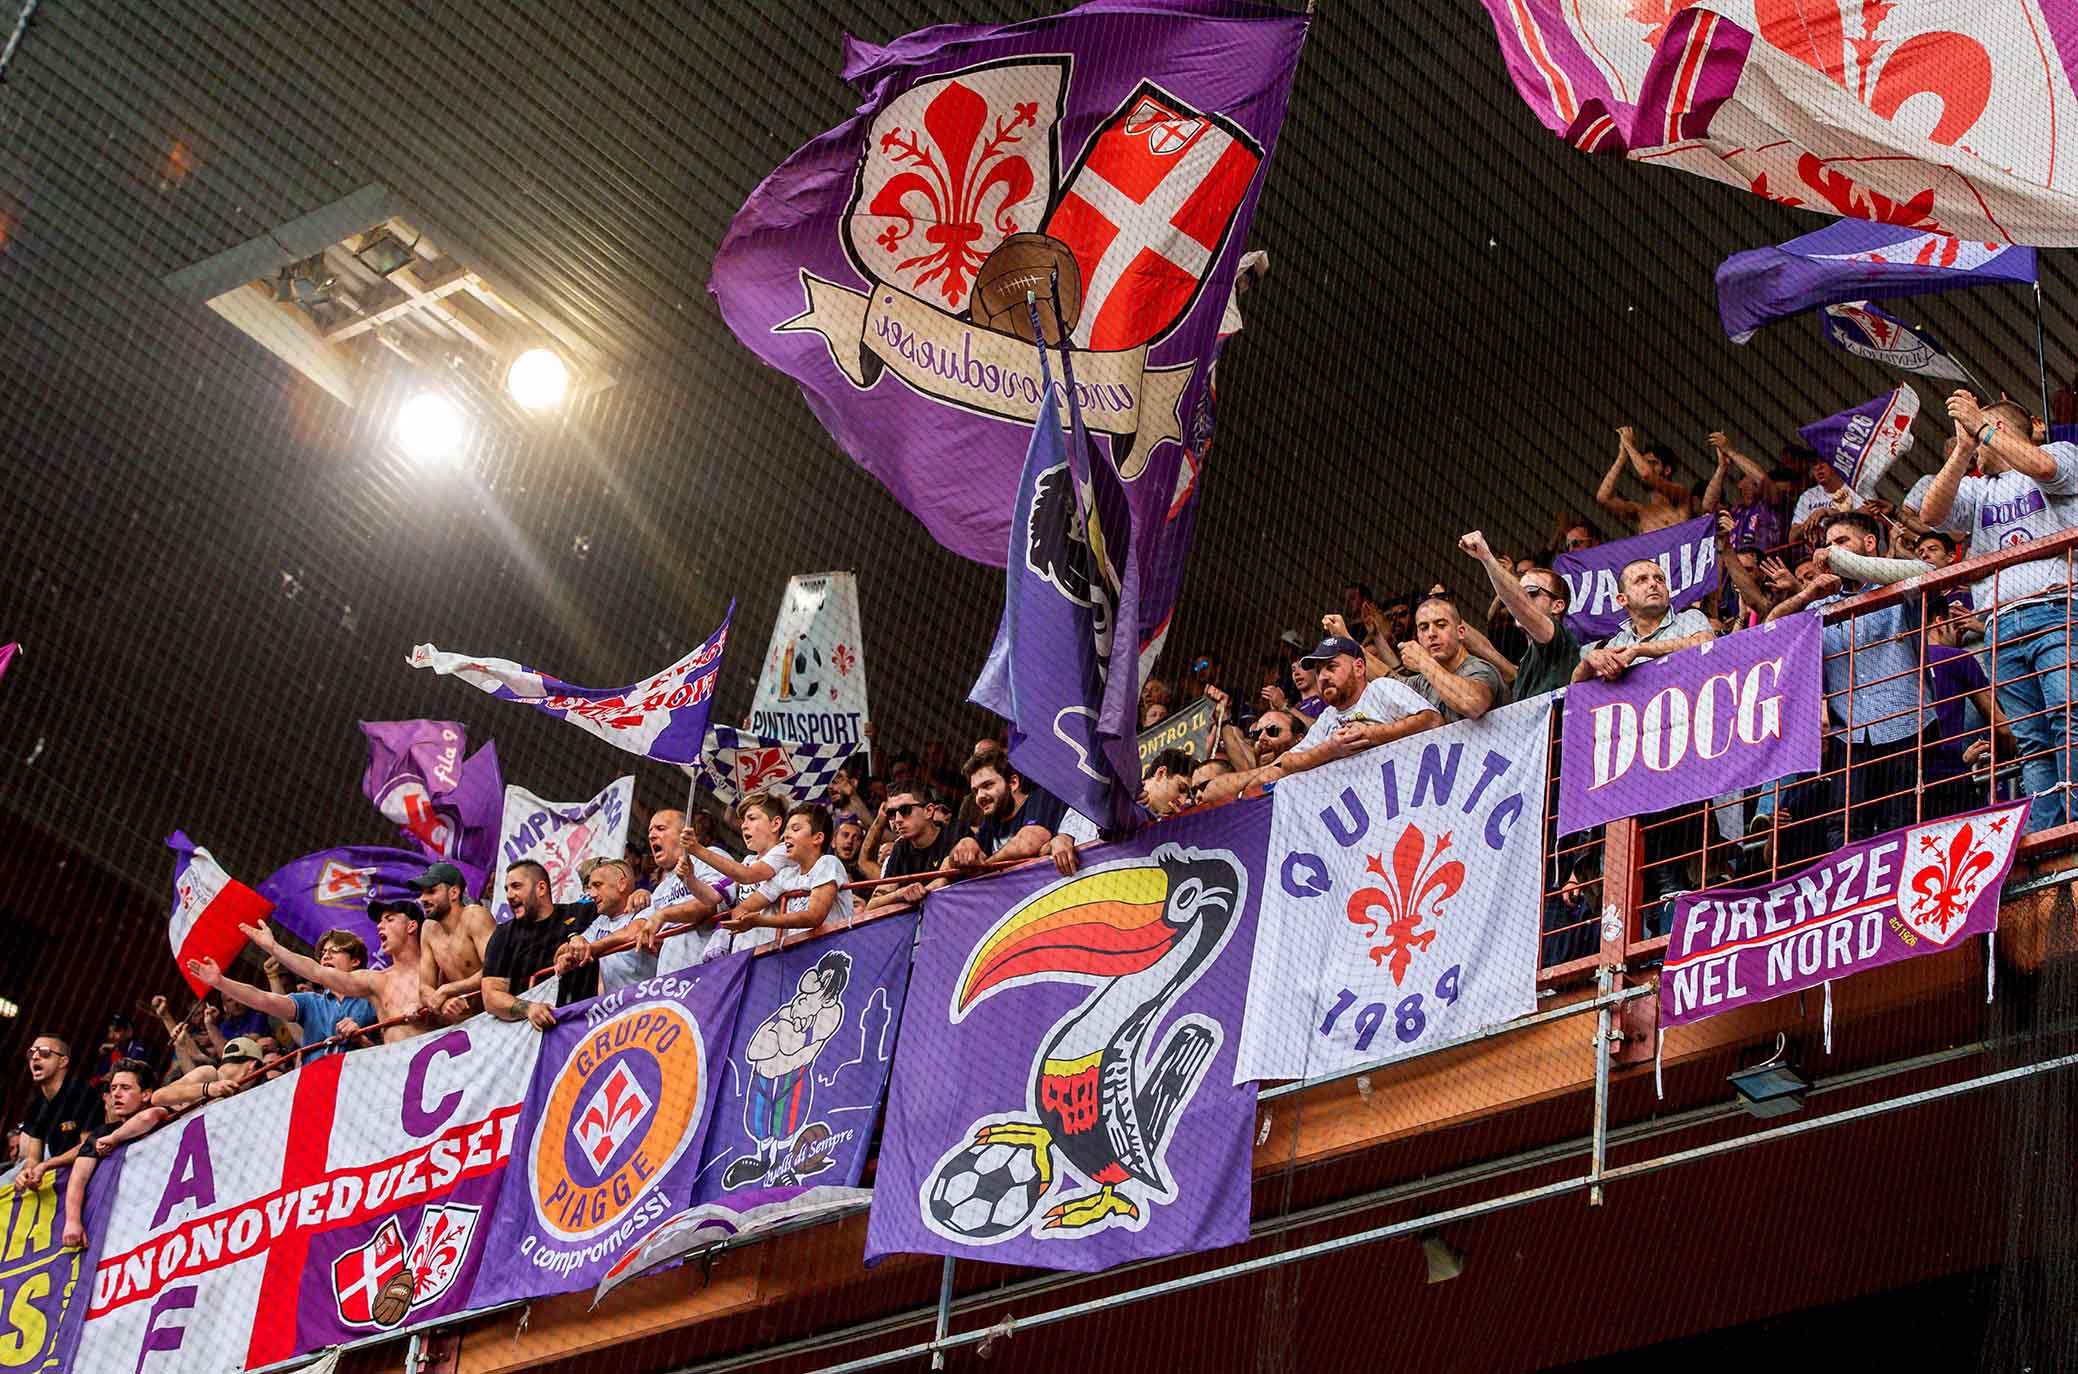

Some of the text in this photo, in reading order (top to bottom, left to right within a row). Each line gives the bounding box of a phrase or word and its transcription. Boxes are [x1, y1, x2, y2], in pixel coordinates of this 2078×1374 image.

[1841, 414, 1874, 451] 1926
[1561, 535, 1716, 617] VALIA
[752, 710, 861, 745] PINTASPORT
[1138, 710, 1207, 760] ONTRO IL
[1588, 656, 1785, 791] DOCG
[433, 747, 458, 788] fila
[1681, 840, 1899, 956] FIRENZE
[635, 977, 701, 1000] scesi
[1672, 910, 1884, 1017] NEL NORD
[576, 1013, 681, 1078] GRUPPO
[1318, 963, 1462, 1052] 1989
[402, 1030, 472, 1138] C
[150, 1114, 217, 1232] A
[808, 1128, 854, 1157] Sempre
[92, 1114, 520, 1311] UNONOVEDUESEI
[545, 1151, 655, 1226] PIAGGE
[521, 1185, 672, 1280] a compromessi
